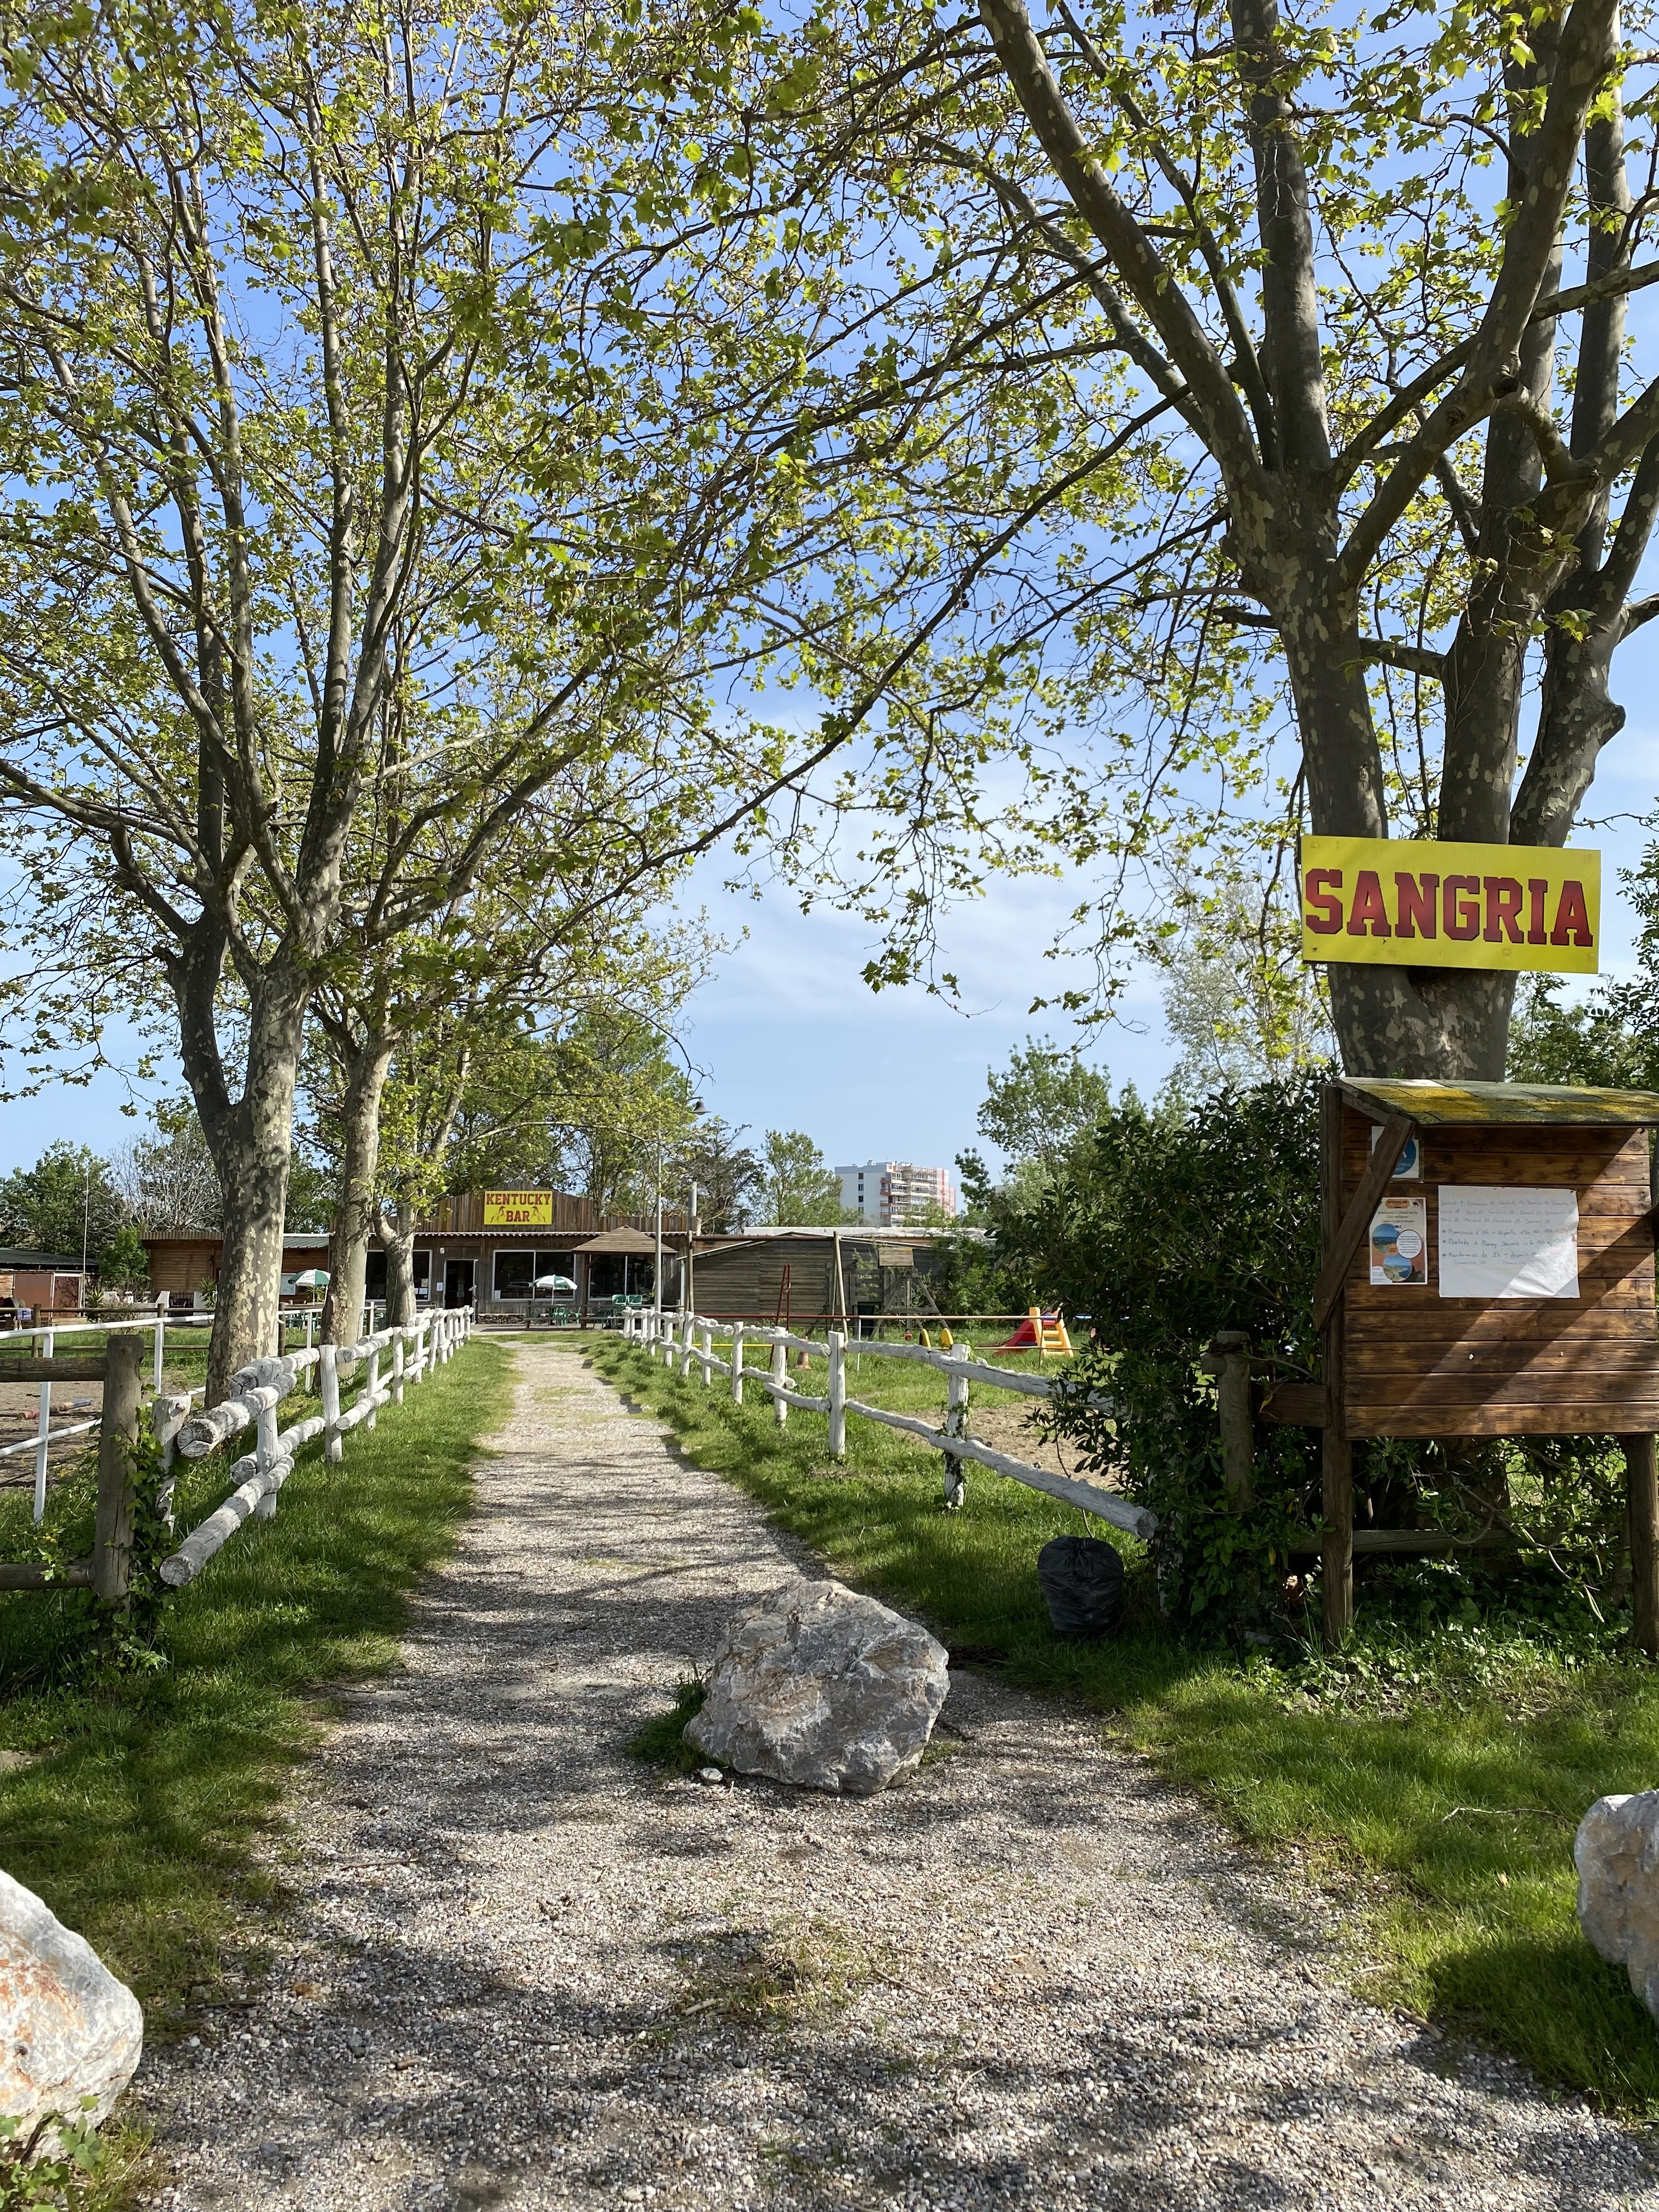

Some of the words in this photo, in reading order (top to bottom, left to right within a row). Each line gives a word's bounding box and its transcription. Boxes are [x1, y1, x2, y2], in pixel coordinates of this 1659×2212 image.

[1306, 868, 1593, 947] SANGRIA
[486, 1194, 551, 1205] KENTUCKY
[506, 1211, 530, 1222] BAR
[22, 1310, 27, 1319] F
